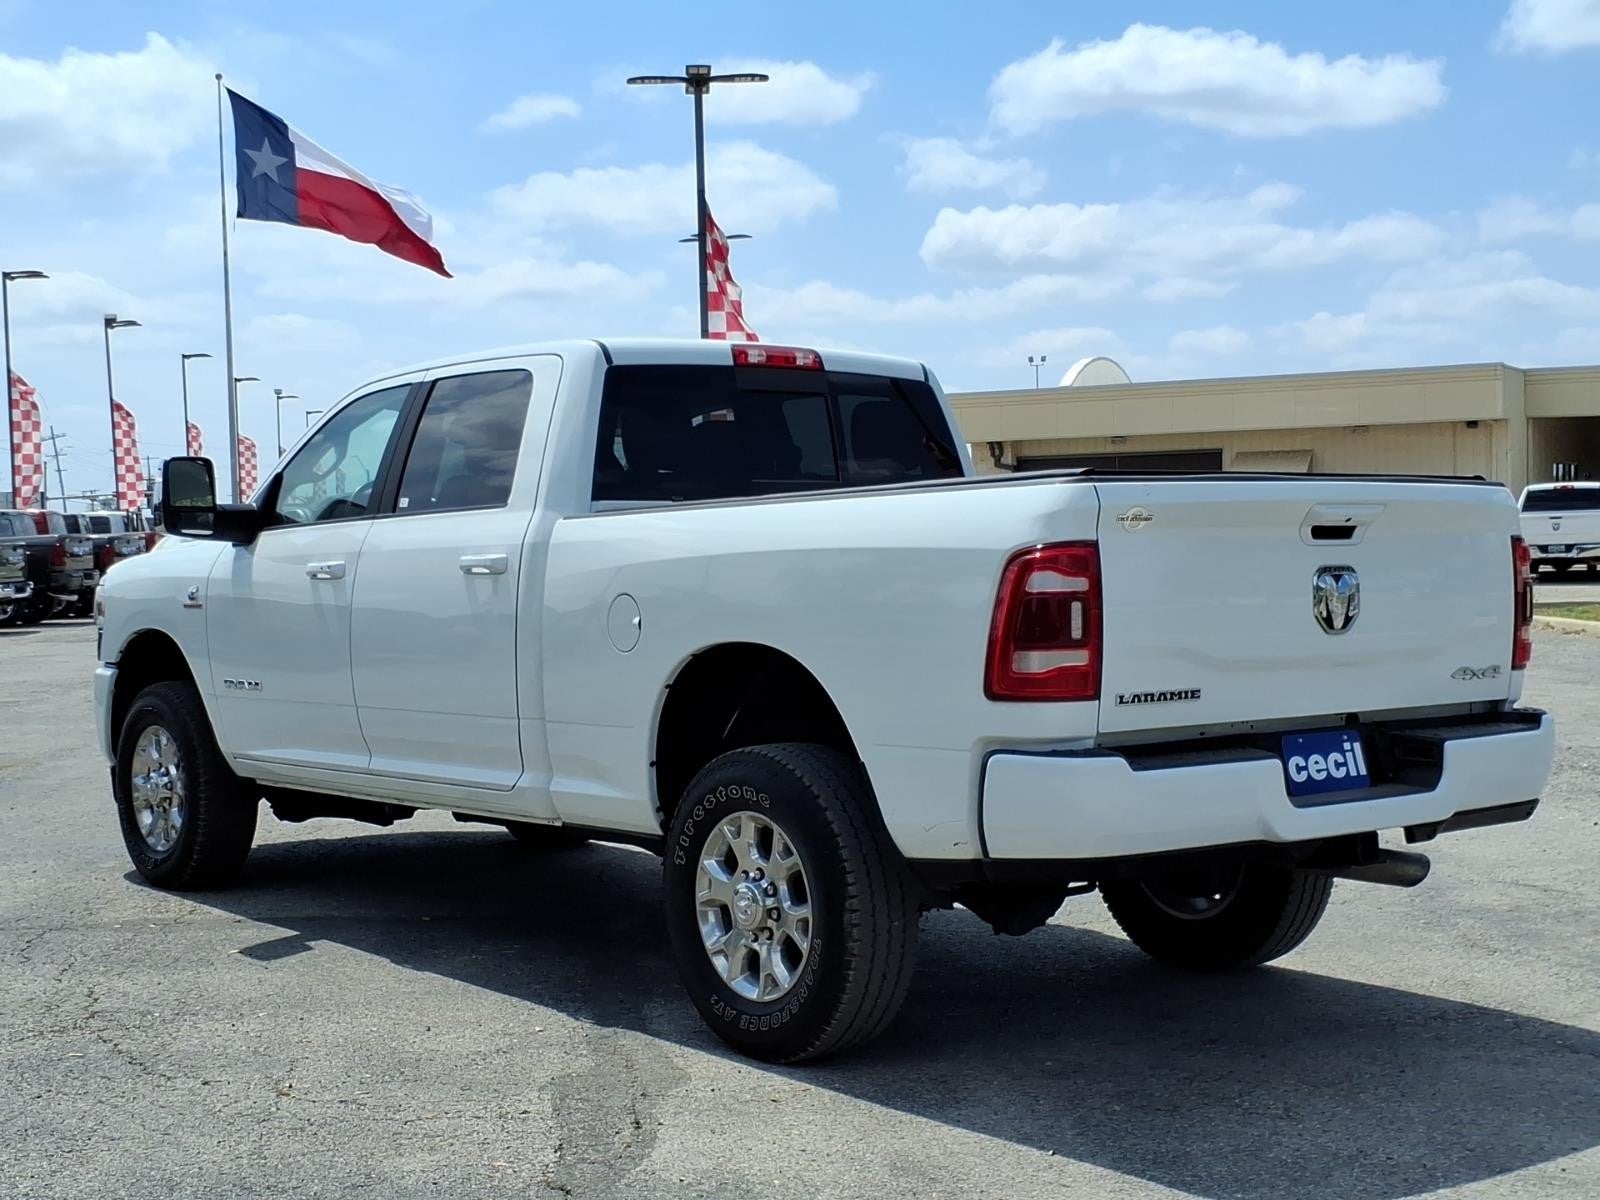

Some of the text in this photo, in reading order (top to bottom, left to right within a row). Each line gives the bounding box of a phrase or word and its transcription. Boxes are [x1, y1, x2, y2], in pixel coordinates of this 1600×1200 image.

[1116, 688, 1201, 706] LARAMIE
[1288, 741, 1367, 783] cecil
[673, 785, 772, 866] Firestone
